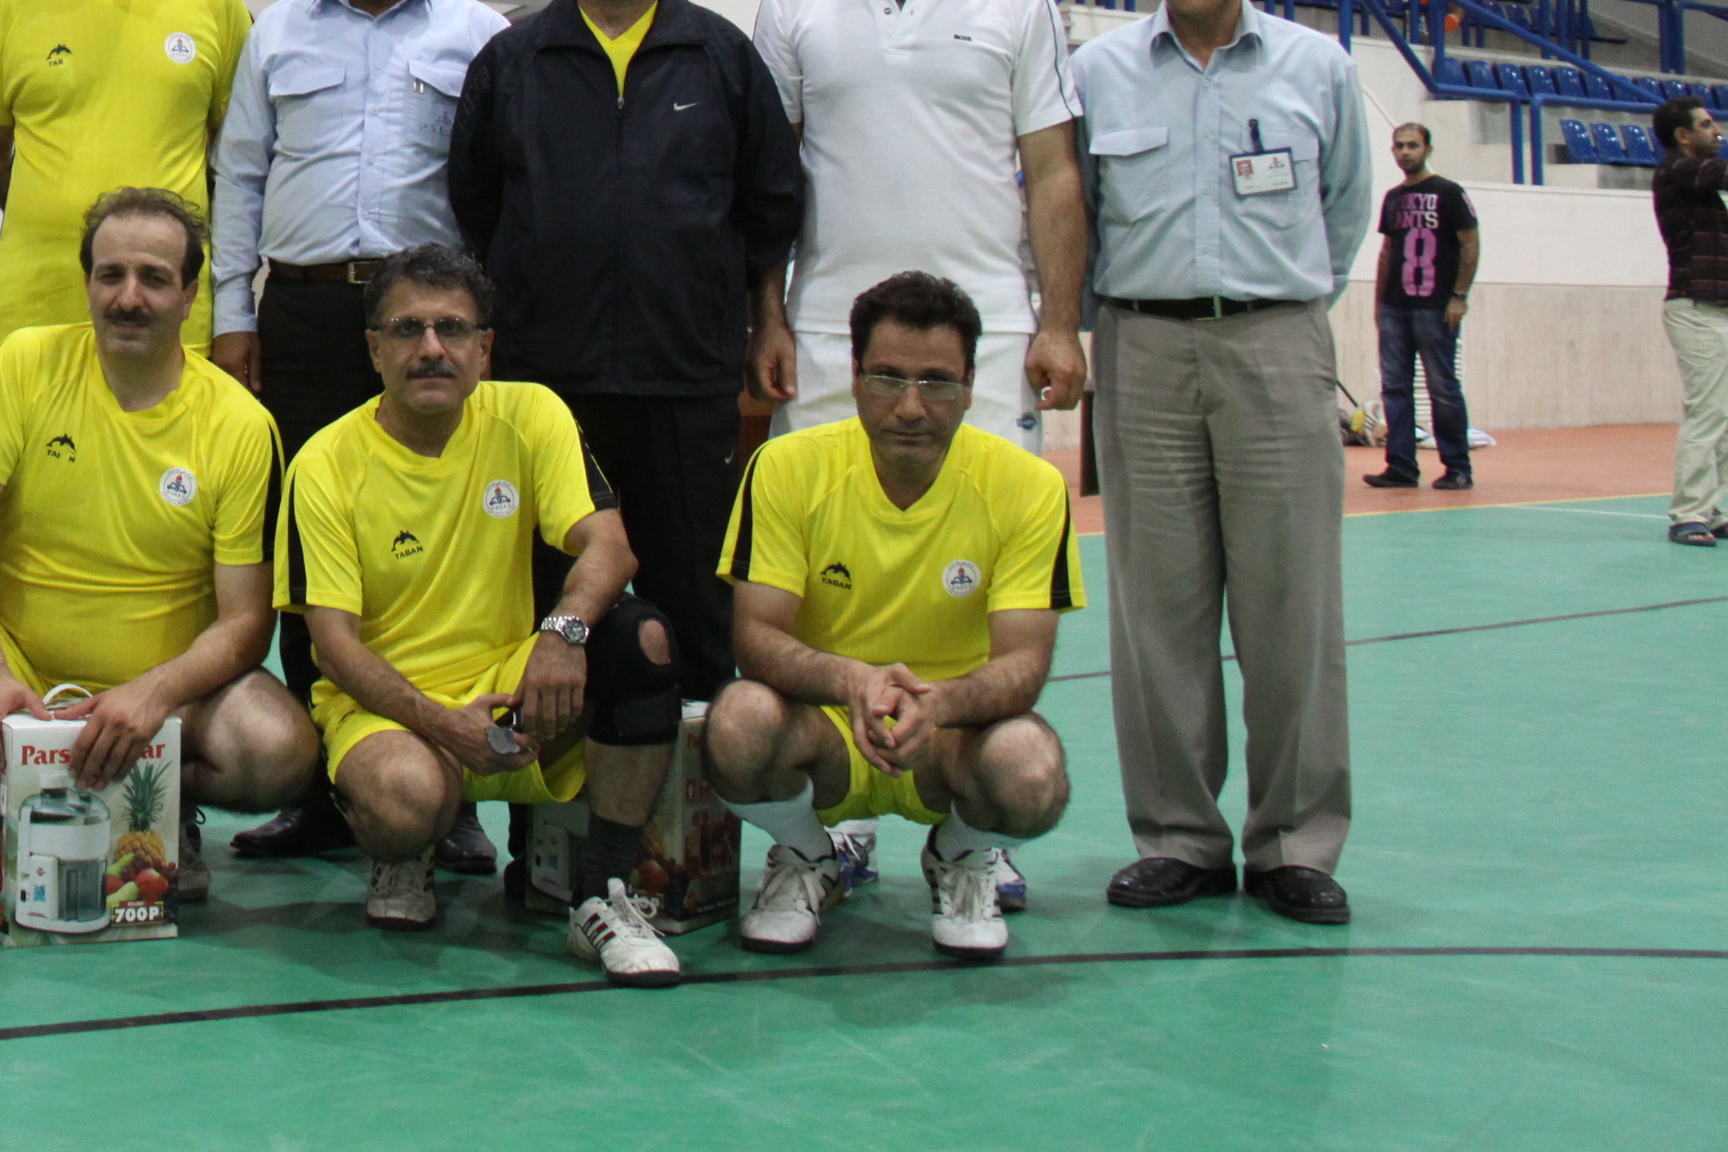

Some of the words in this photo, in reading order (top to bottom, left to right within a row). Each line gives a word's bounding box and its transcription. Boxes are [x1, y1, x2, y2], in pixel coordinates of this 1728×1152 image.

[48, 59, 64, 67] TAB
[1402, 228, 1437, 297] 8
[394, 545, 424, 559] TABAN
[821, 576, 852, 590] TABAN
[21, 744, 72, 766] Pars
[114, 906, 160, 923] 700P
